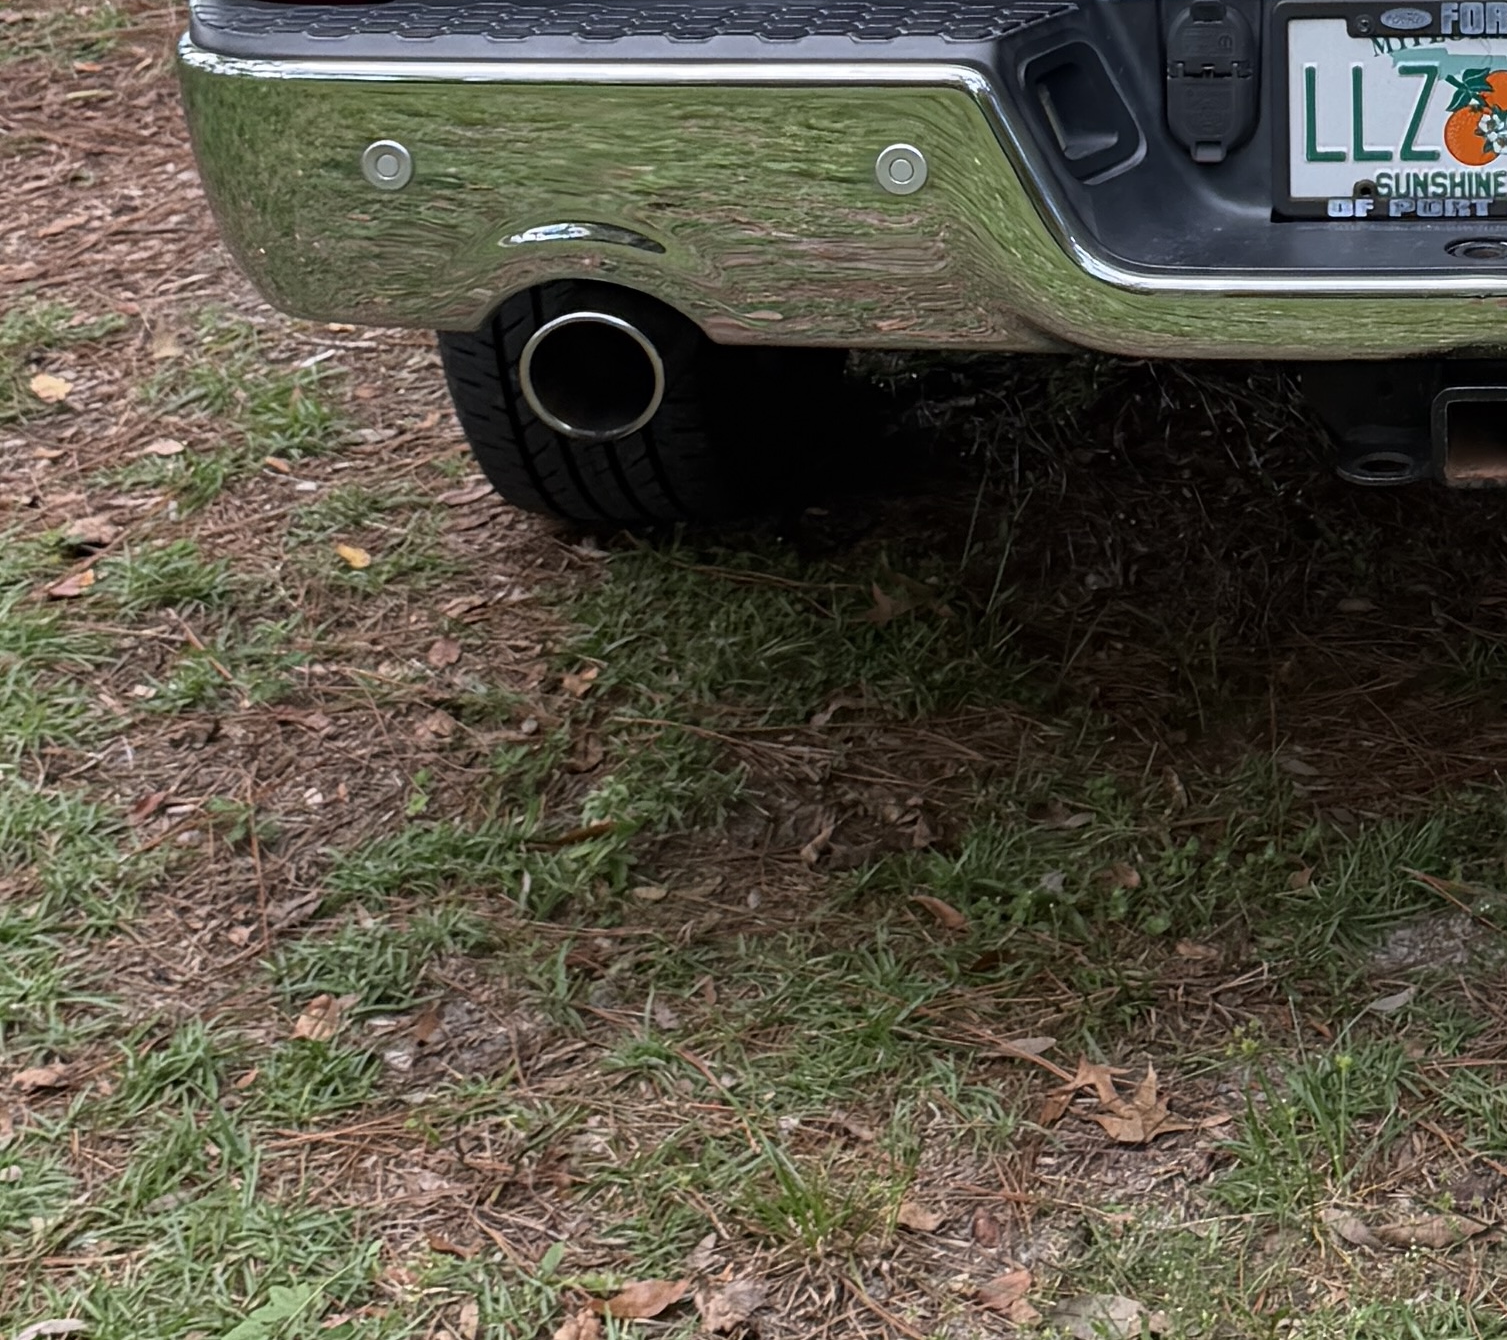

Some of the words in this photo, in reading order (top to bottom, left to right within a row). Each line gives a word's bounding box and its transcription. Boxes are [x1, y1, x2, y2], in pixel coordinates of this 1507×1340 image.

[1304, 65, 1441, 162] LLZ
[1375, 171, 1507, 198] SUNSHINE
[1327, 199, 1375, 218] OF
[1389, 199, 1494, 217] PORT
